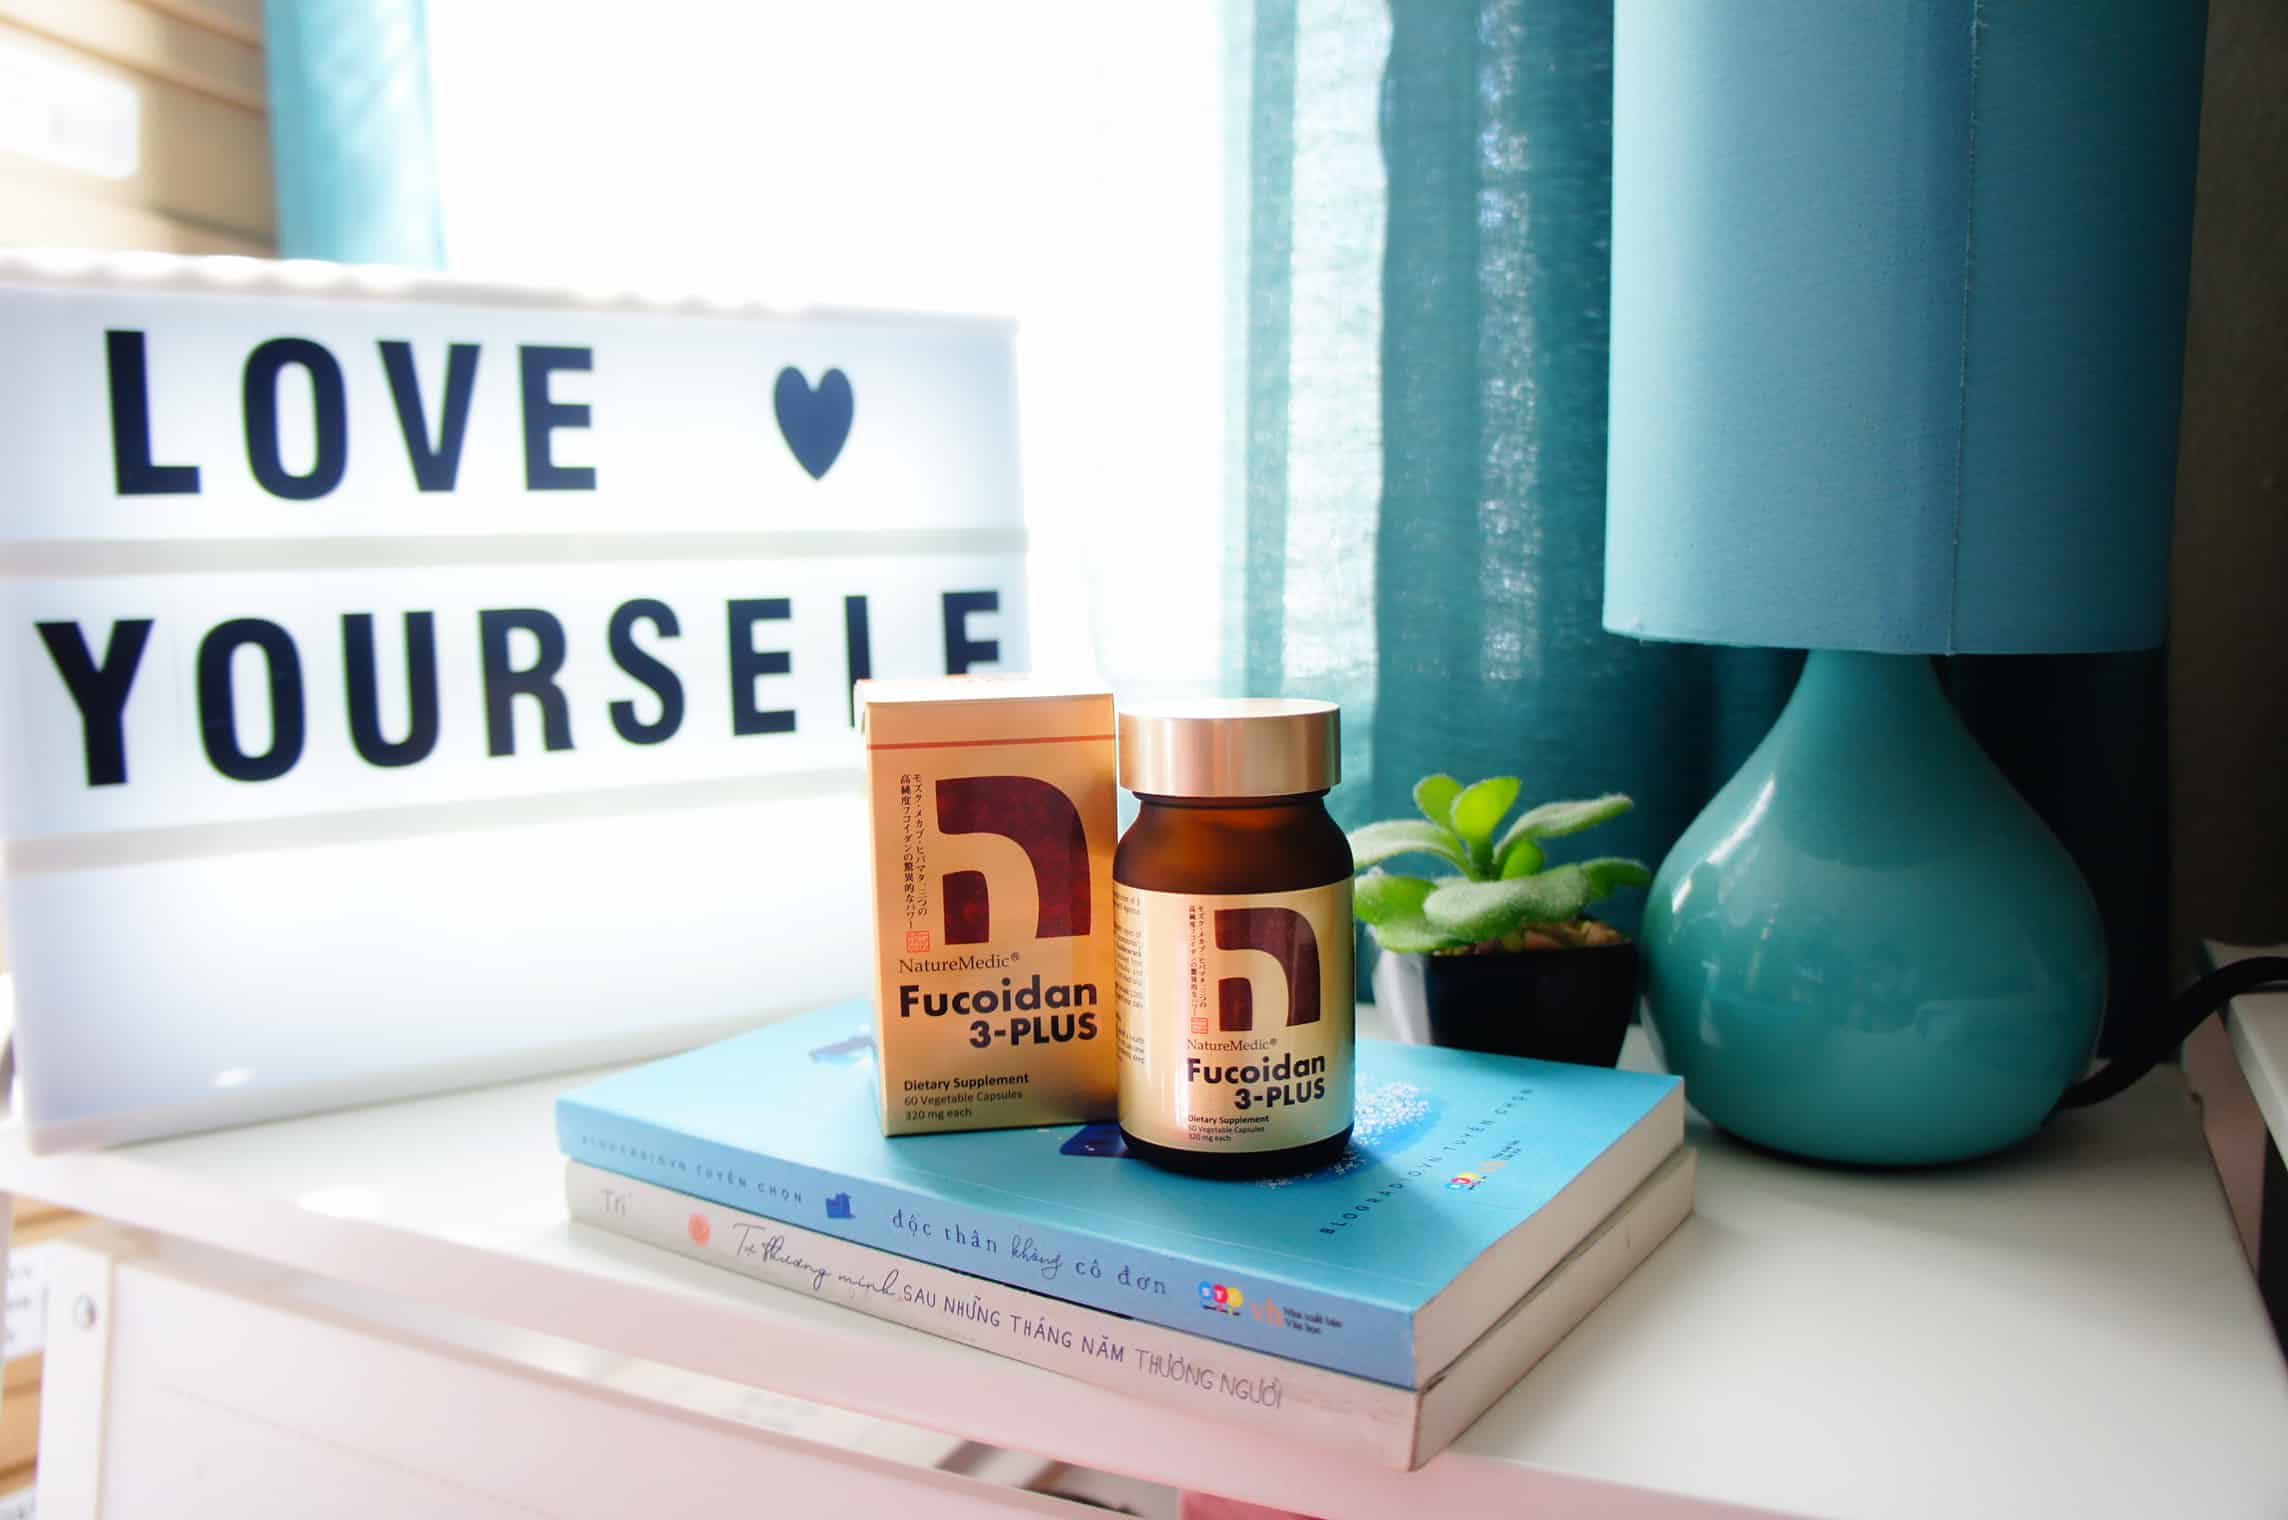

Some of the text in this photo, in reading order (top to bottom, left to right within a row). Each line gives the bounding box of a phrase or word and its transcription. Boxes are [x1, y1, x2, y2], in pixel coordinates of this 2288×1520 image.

[105, 329, 597, 501] LOVE
[900, 974, 1097, 1017] Fucoidan
[969, 1012, 1098, 1048] 3-PLUS
[904, 1073, 1029, 1092] Dietary Supplement
[1188, 1053, 1325, 1084] Fucoidan
[904, 1090, 1023, 1106] 60 Vegetable Capsules
[1234, 1078, 1325, 1110] 3-PLUS
[905, 1108, 972, 1121] 320 mg each
[1188, 1115, 1269, 1124] Dietary Supplement
[893, 1209, 932, 1237] độc
[945, 1224, 997, 1253] thân
[1076, 1259, 1102, 1279] cô
[1118, 1265, 1167, 1295] đơn
[903, 1285, 936, 1308] SAU
[944, 1295, 1000, 1327] NHỮNG
[1010, 1314, 1072, 1348] THÁNG
[1081, 1334, 1124, 1362] NĂM
